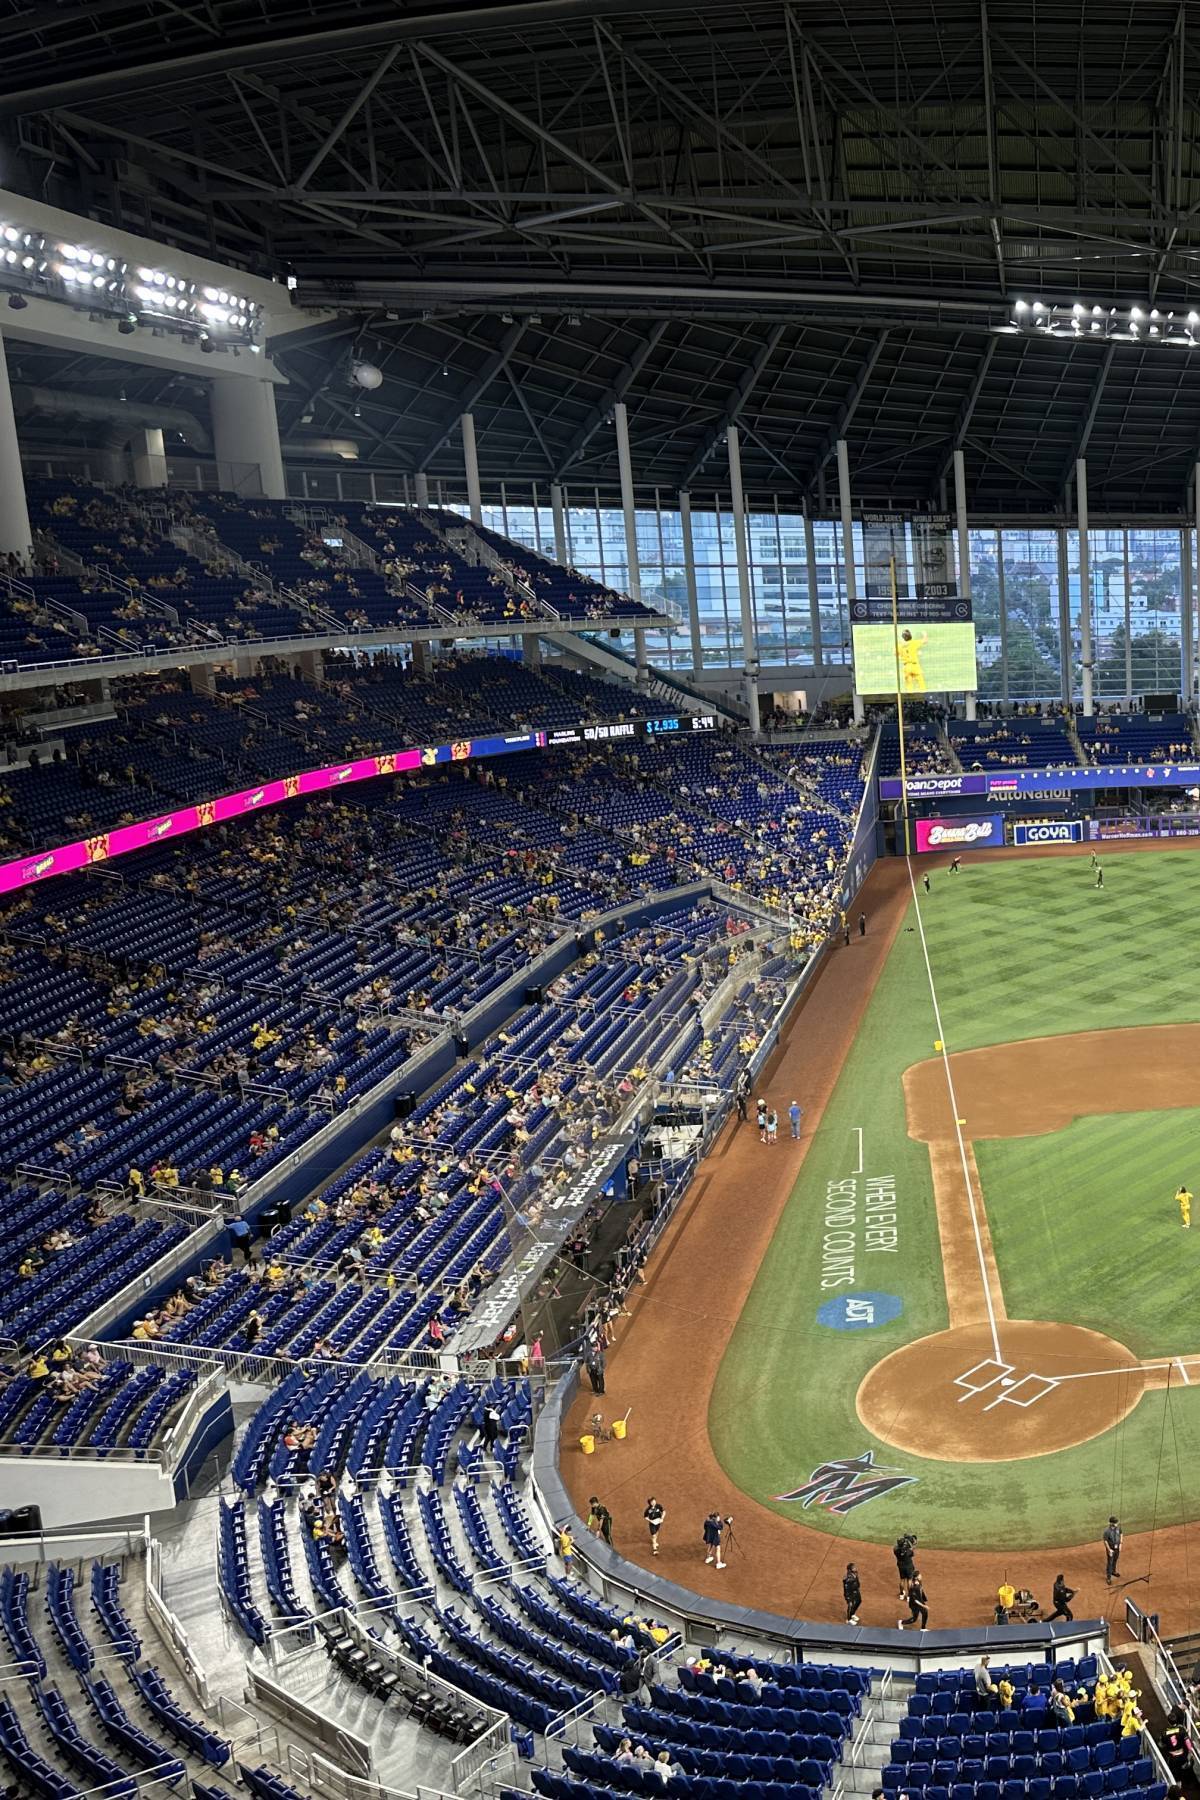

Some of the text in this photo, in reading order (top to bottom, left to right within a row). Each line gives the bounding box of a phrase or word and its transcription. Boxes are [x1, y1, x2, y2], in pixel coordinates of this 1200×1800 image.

[924, 585, 948, 596] 2003
[646, 722, 653, 733] $
[692, 716, 714, 729] 5:44
[609, 724, 635, 737] RAFFLE
[986, 789, 1072, 802] AutoNation
[1028, 826, 1069, 841] GOYA
[865, 1174, 897, 1212] WHEN
[820, 1178, 857, 1291] SECOND COUNTS.
[865, 1215, 899, 1252] EVERY
[845, 1298, 875, 1324] ADT
